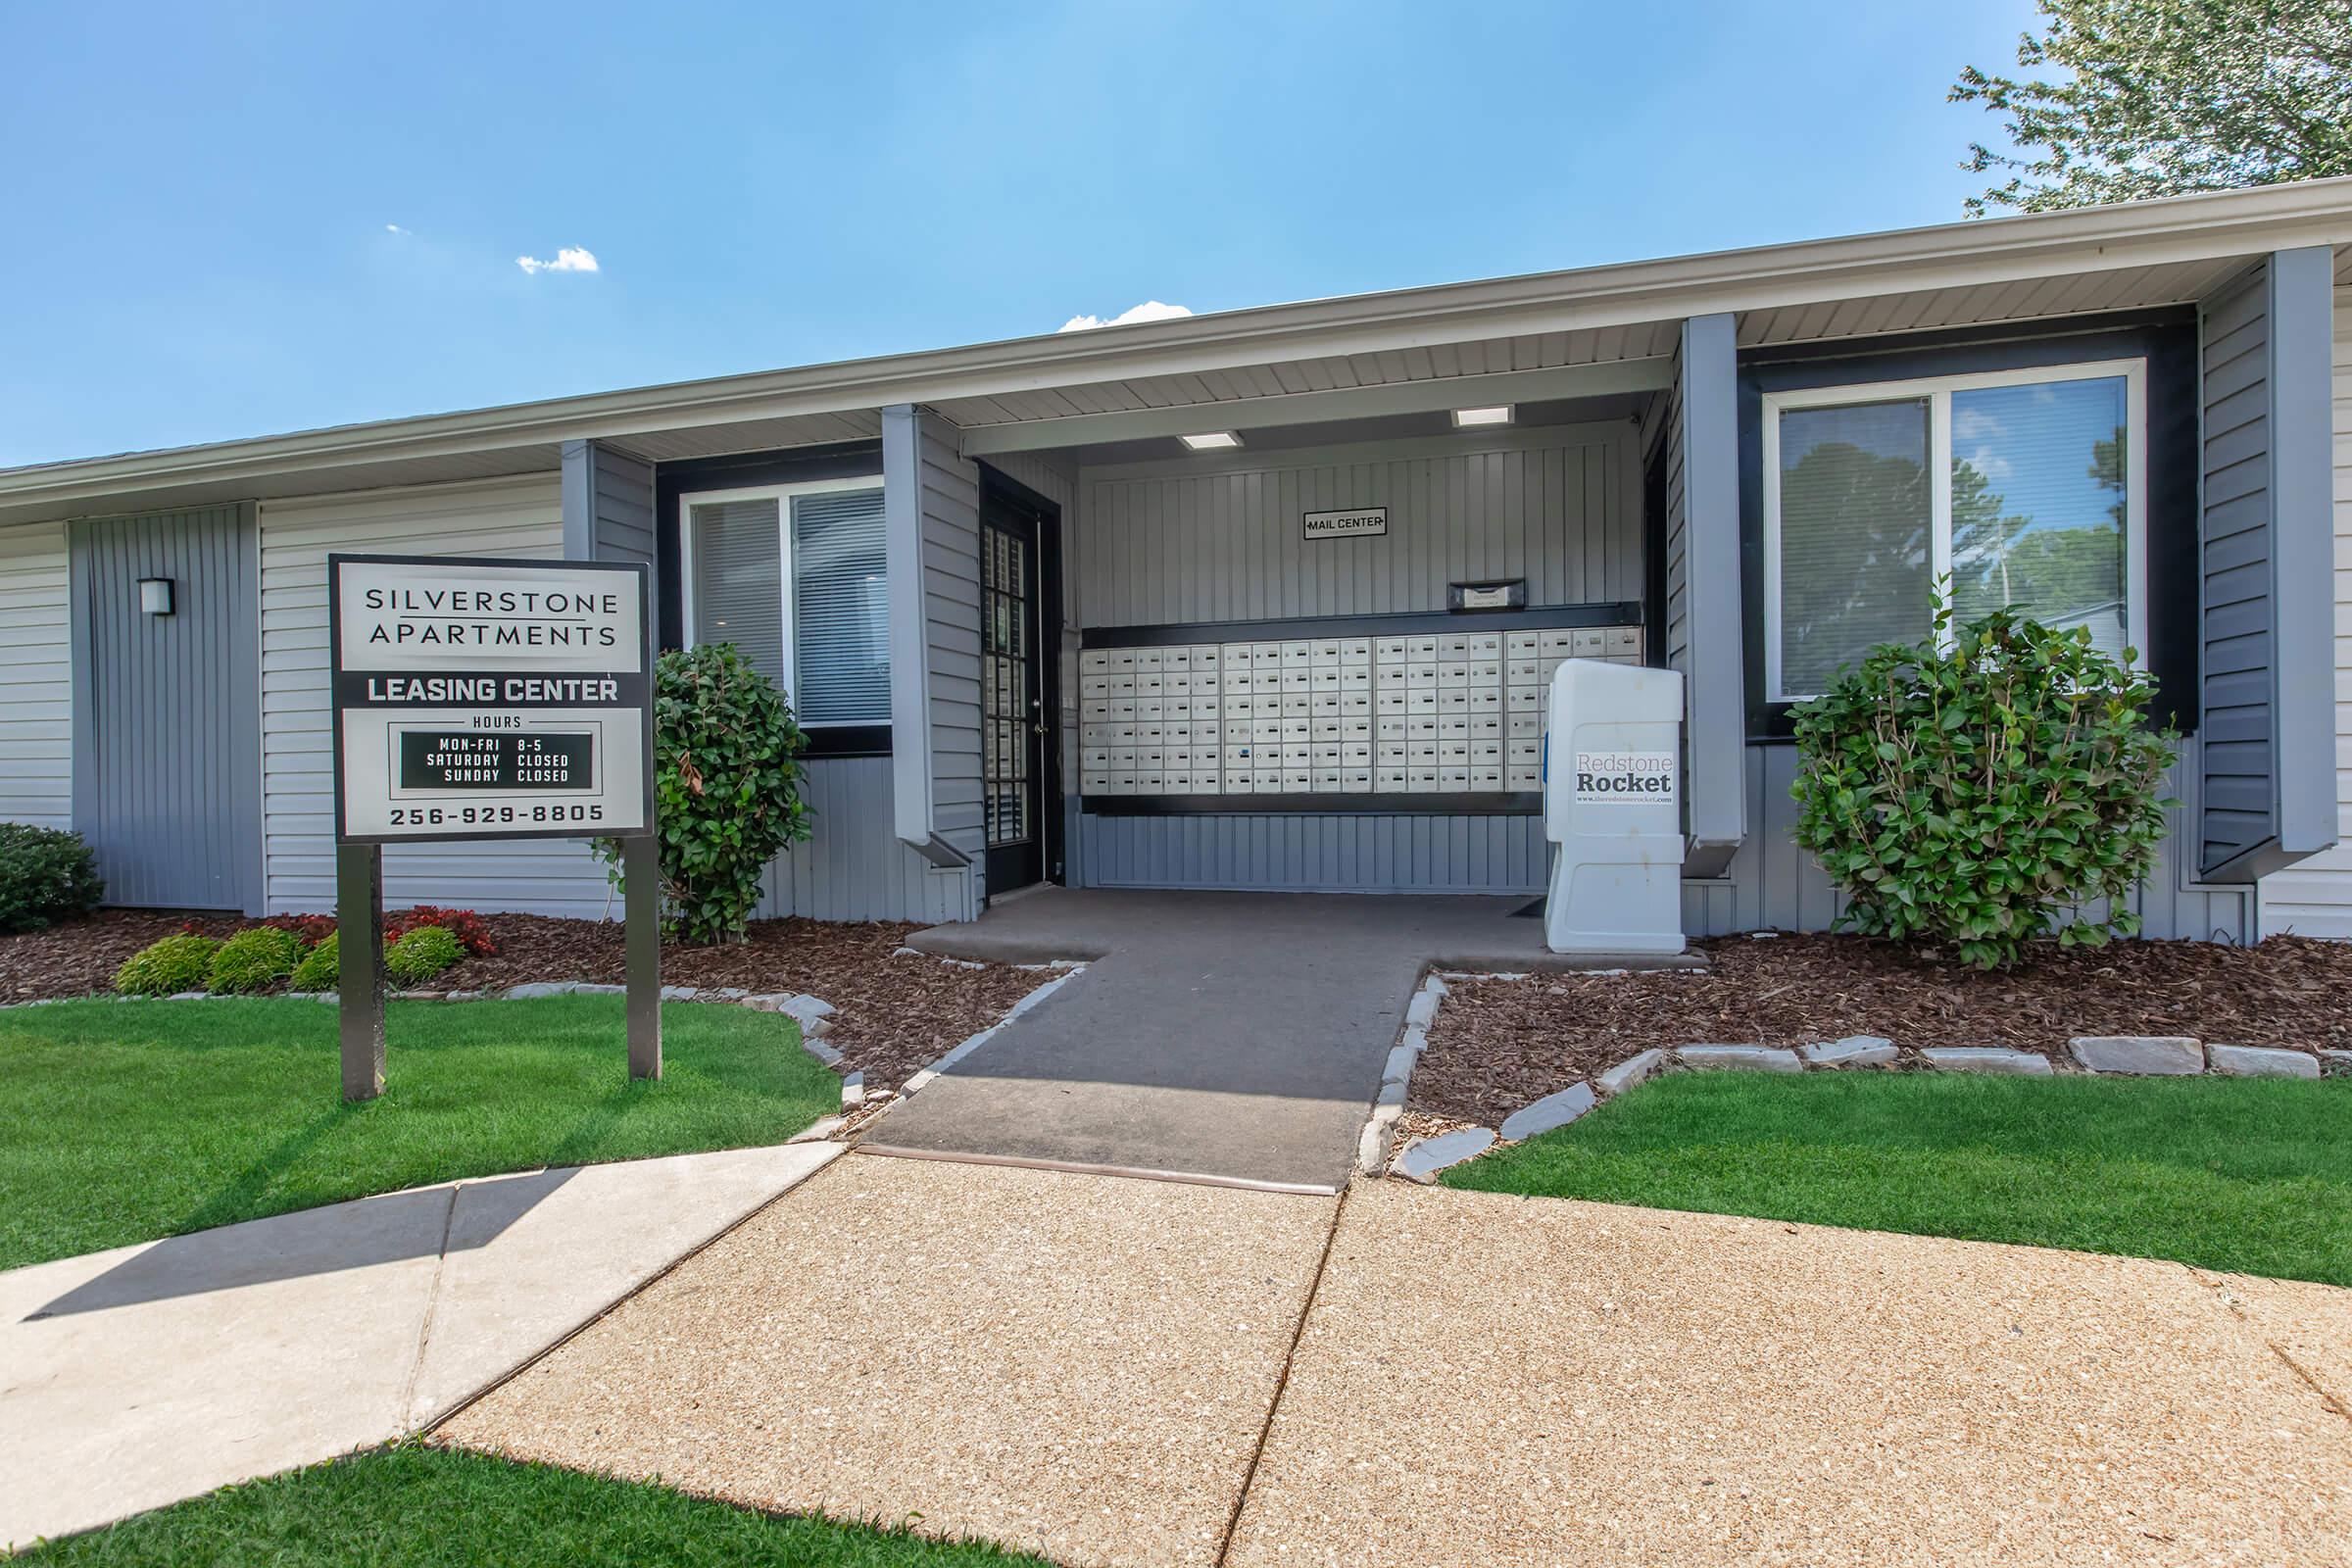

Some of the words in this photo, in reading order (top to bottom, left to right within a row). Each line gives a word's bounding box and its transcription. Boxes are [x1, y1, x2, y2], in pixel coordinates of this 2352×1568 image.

[1308, 519, 1336, 530] MAIL
[1338, 516, 1382, 528] CENTER
[366, 589, 618, 614] SILVERSTONE
[369, 623, 616, 646] APARTMENTS
[368, 678, 496, 702] LEASING
[504, 679, 618, 702] CENTER
[473, 716, 521, 728] HOURS
[439, 738, 501, 752] MON-FRI
[517, 739, 542, 752] 8-5
[426, 754, 500, 766] SATURDAY
[517, 755, 568, 767] CLOSED
[1577, 754, 1673, 771] Redstone
[444, 769, 500, 782] SUNDAY
[517, 769, 568, 782] CLOSED
[1576, 772, 1672, 793] Rocket
[390, 805, 604, 825] 256-929-8805
